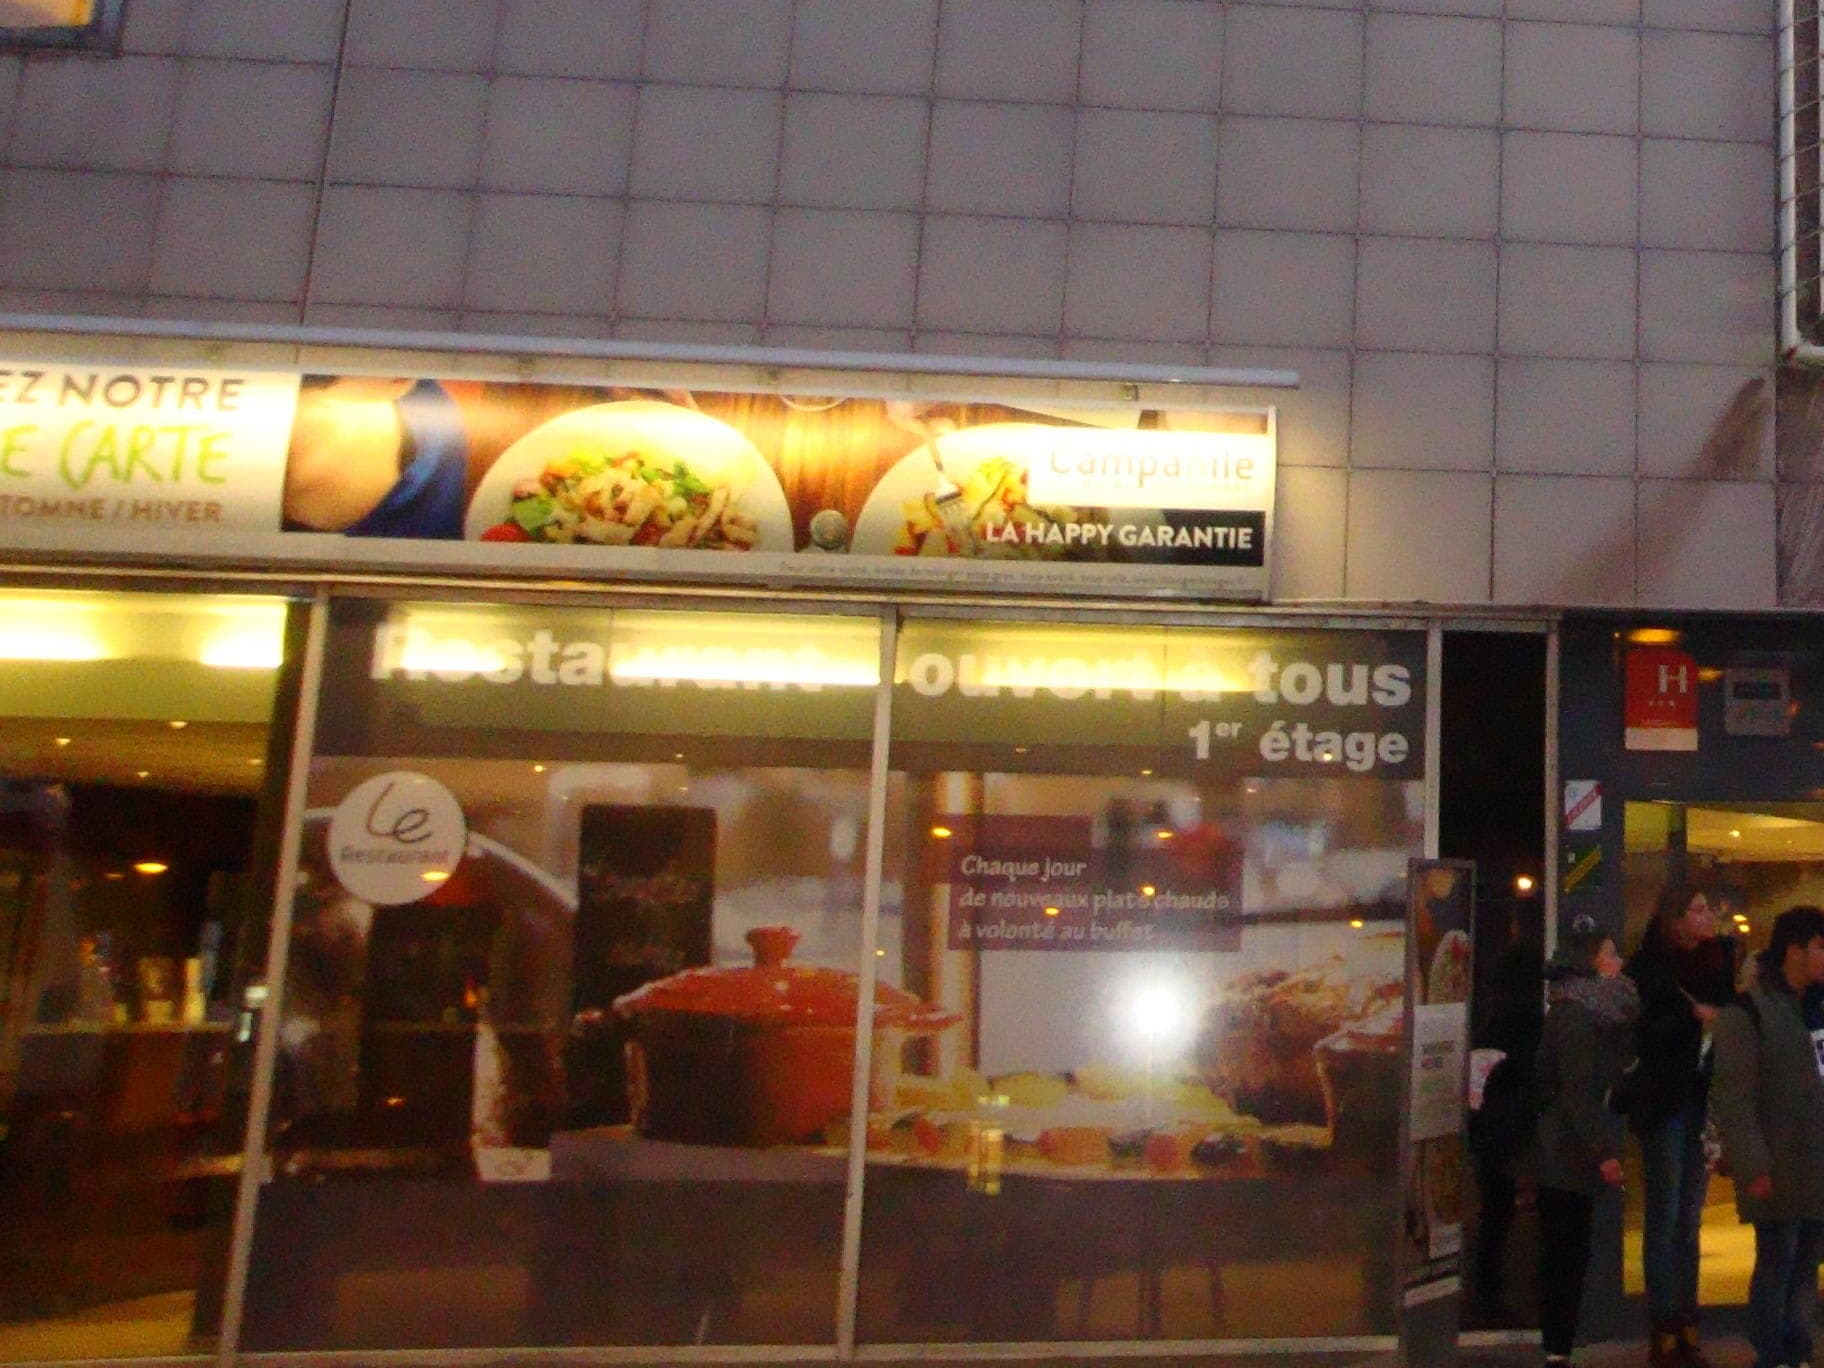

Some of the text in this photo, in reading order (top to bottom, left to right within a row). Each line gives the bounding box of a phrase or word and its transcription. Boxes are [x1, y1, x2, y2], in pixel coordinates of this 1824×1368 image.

[56, 373, 246, 411] NOTRE
[58, 418, 230, 492] CARTE
[131, 498, 224, 522] HIVER
[986, 522, 1254, 550] LA HAPPY GARANTIE
[1249, 648, 1413, 707] tous
[1658, 664, 1688, 694] H
[1187, 718, 1410, 772] 1er étage
[367, 780, 433, 844] Le
[960, 854, 1087, 883] Chaque jour
[958, 889, 987, 908] de
[991, 890, 1089, 909] nouveaux
[957, 919, 972, 939] à
[1060, 923, 1085, 939] au
